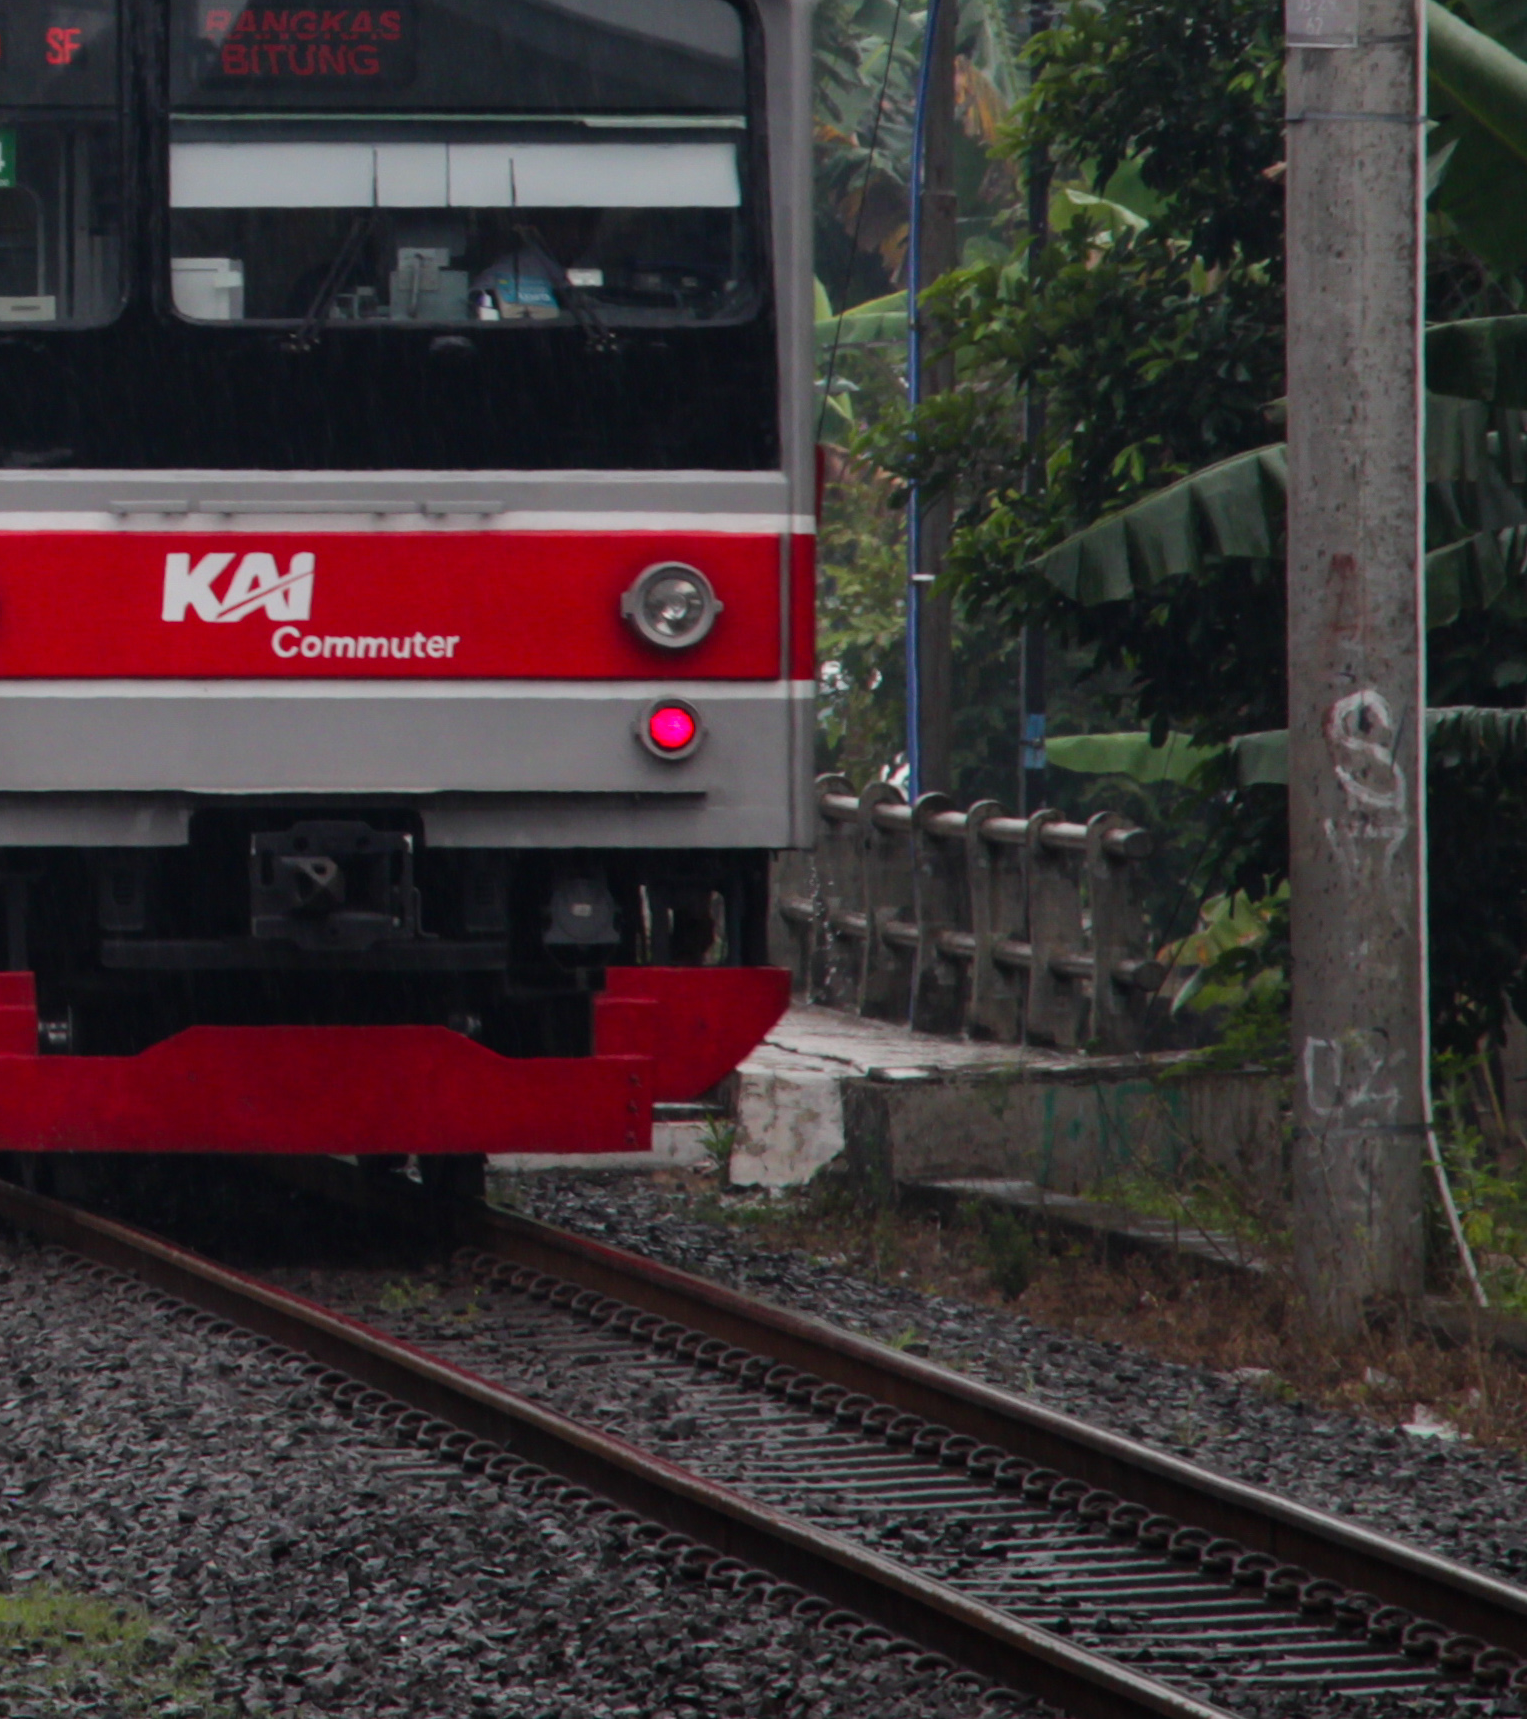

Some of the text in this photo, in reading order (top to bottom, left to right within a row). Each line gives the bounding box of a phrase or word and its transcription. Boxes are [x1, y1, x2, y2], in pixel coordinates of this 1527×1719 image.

[205, 10, 402, 40] RANGKAS
[221, 44, 379, 75] BITUNG
[161, 552, 316, 623] KAI
[271, 626, 461, 659] Commuter
